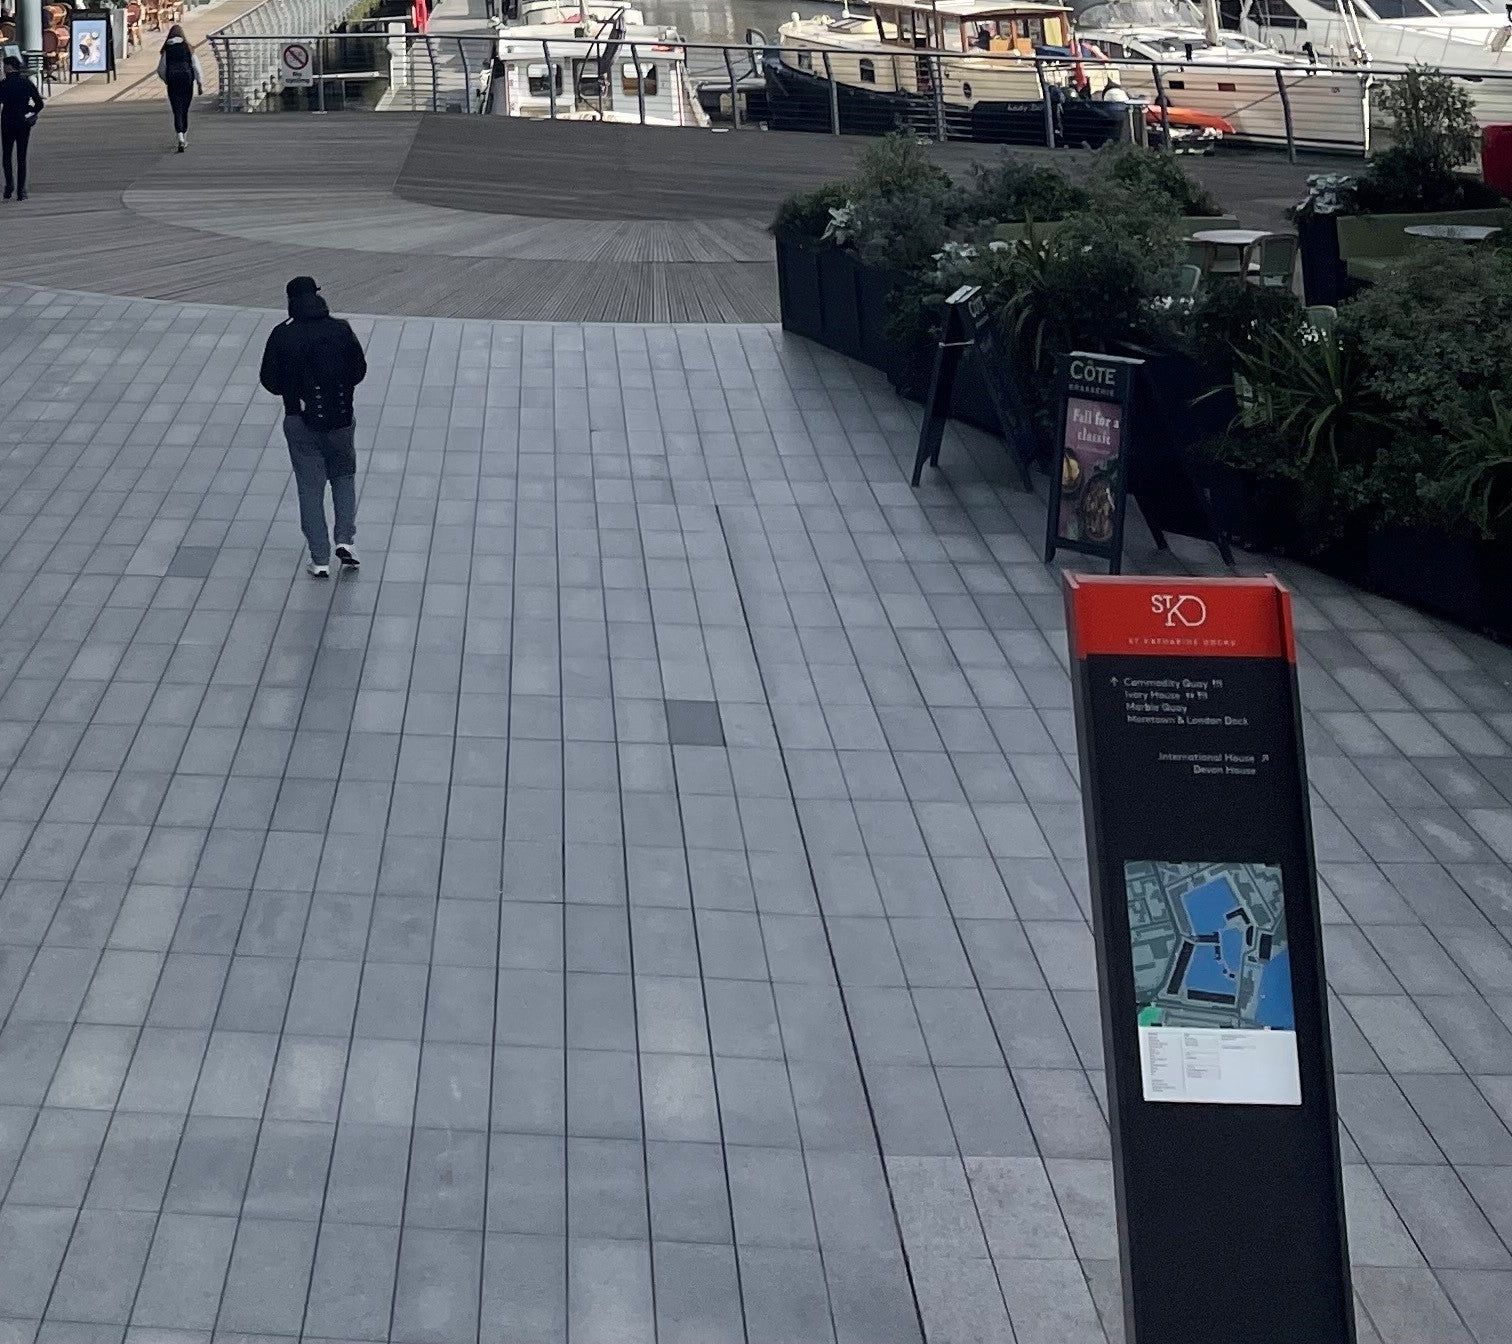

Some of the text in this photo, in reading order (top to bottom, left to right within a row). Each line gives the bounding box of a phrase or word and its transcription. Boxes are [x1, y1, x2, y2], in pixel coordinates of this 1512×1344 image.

[1094, 411, 1112, 427] for
[1182, 678, 1208, 690] Quay
[1150, 691, 1181, 700] House
[1161, 703, 1187, 714] Quay
[1186, 716, 1223, 725] London
[1158, 752, 1255, 763] International House
[1193, 764, 1256, 775] Devon House
